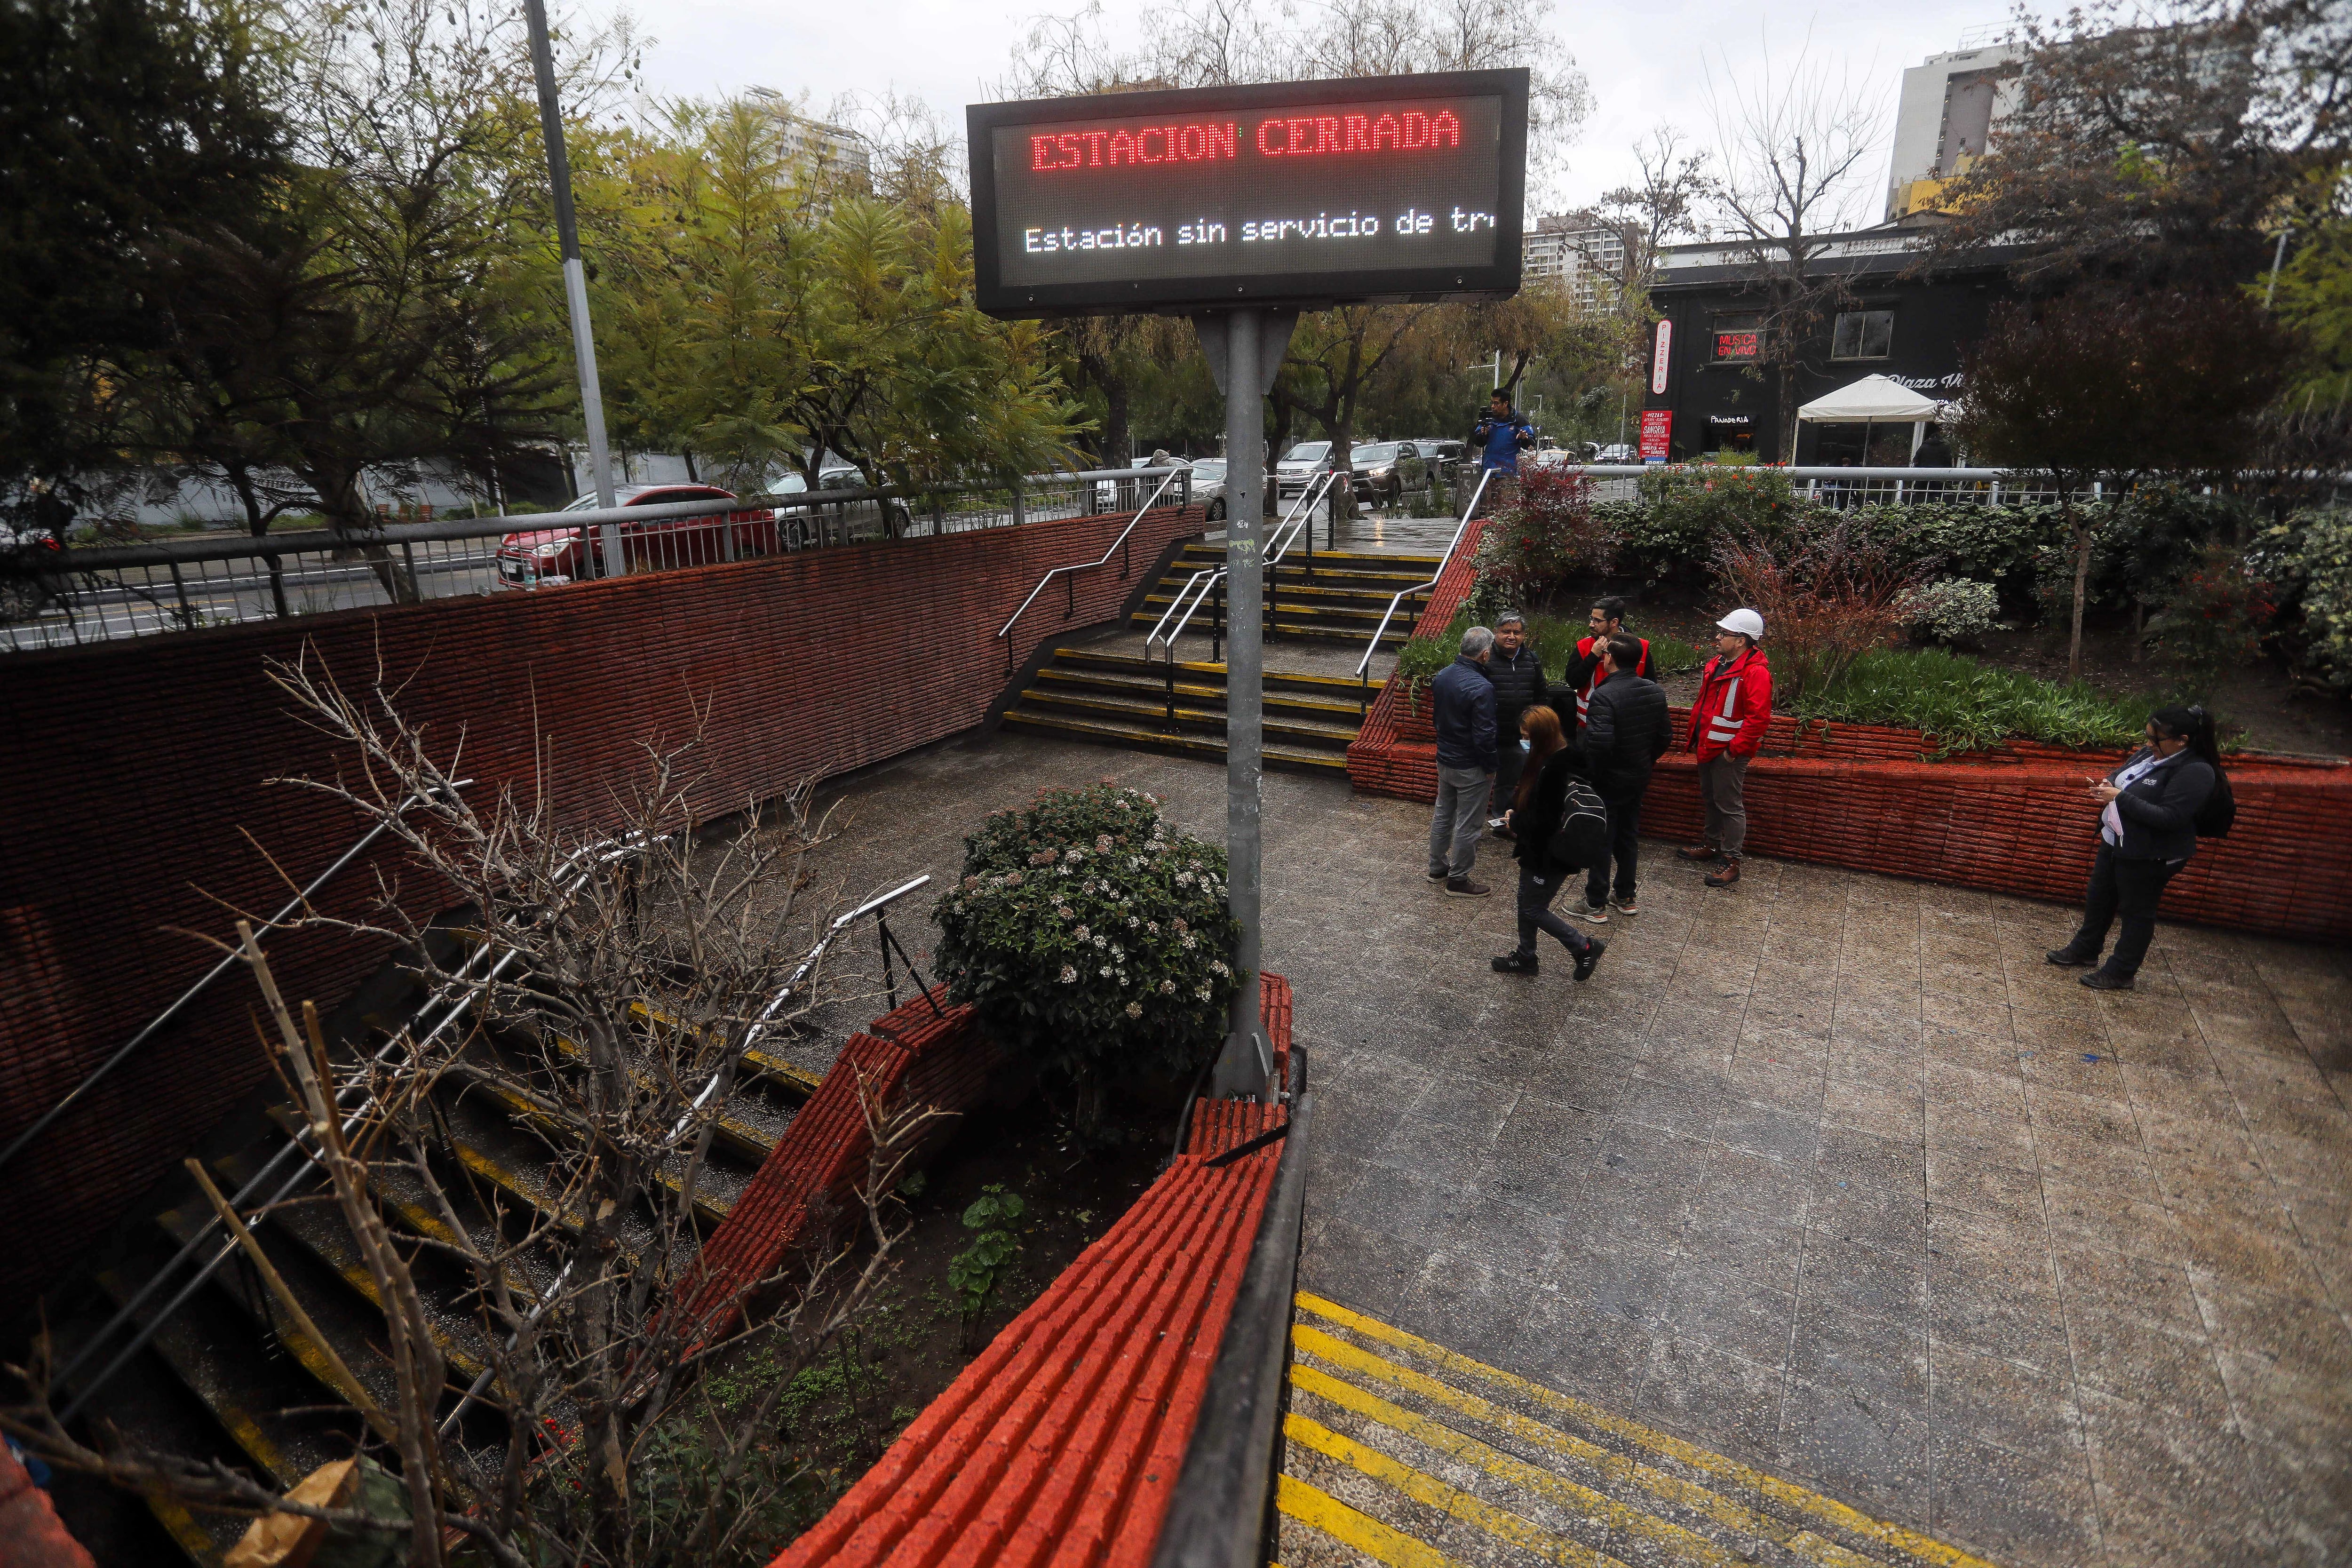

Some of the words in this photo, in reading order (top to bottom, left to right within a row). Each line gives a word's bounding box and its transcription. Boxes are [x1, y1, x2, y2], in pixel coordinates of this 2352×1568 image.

[1031, 122, 1234, 170] ESTACION
[1258, 110, 1459, 156] CERRADA
[1025, 222, 1161, 253] Estación
[1178, 218, 1225, 245] sin
[1242, 210, 1378, 241] servicio
[1396, 207, 1433, 235] de
[1451, 206, 1495, 231] tr
[1657, 324, 1667, 389] PIZZERIA
[1718, 346, 1731, 356] EN
[1735, 345, 1757, 356] VIVO
[1941, 373, 1963, 389] Vi
[1643, 425, 1665, 434] SANGRIA
